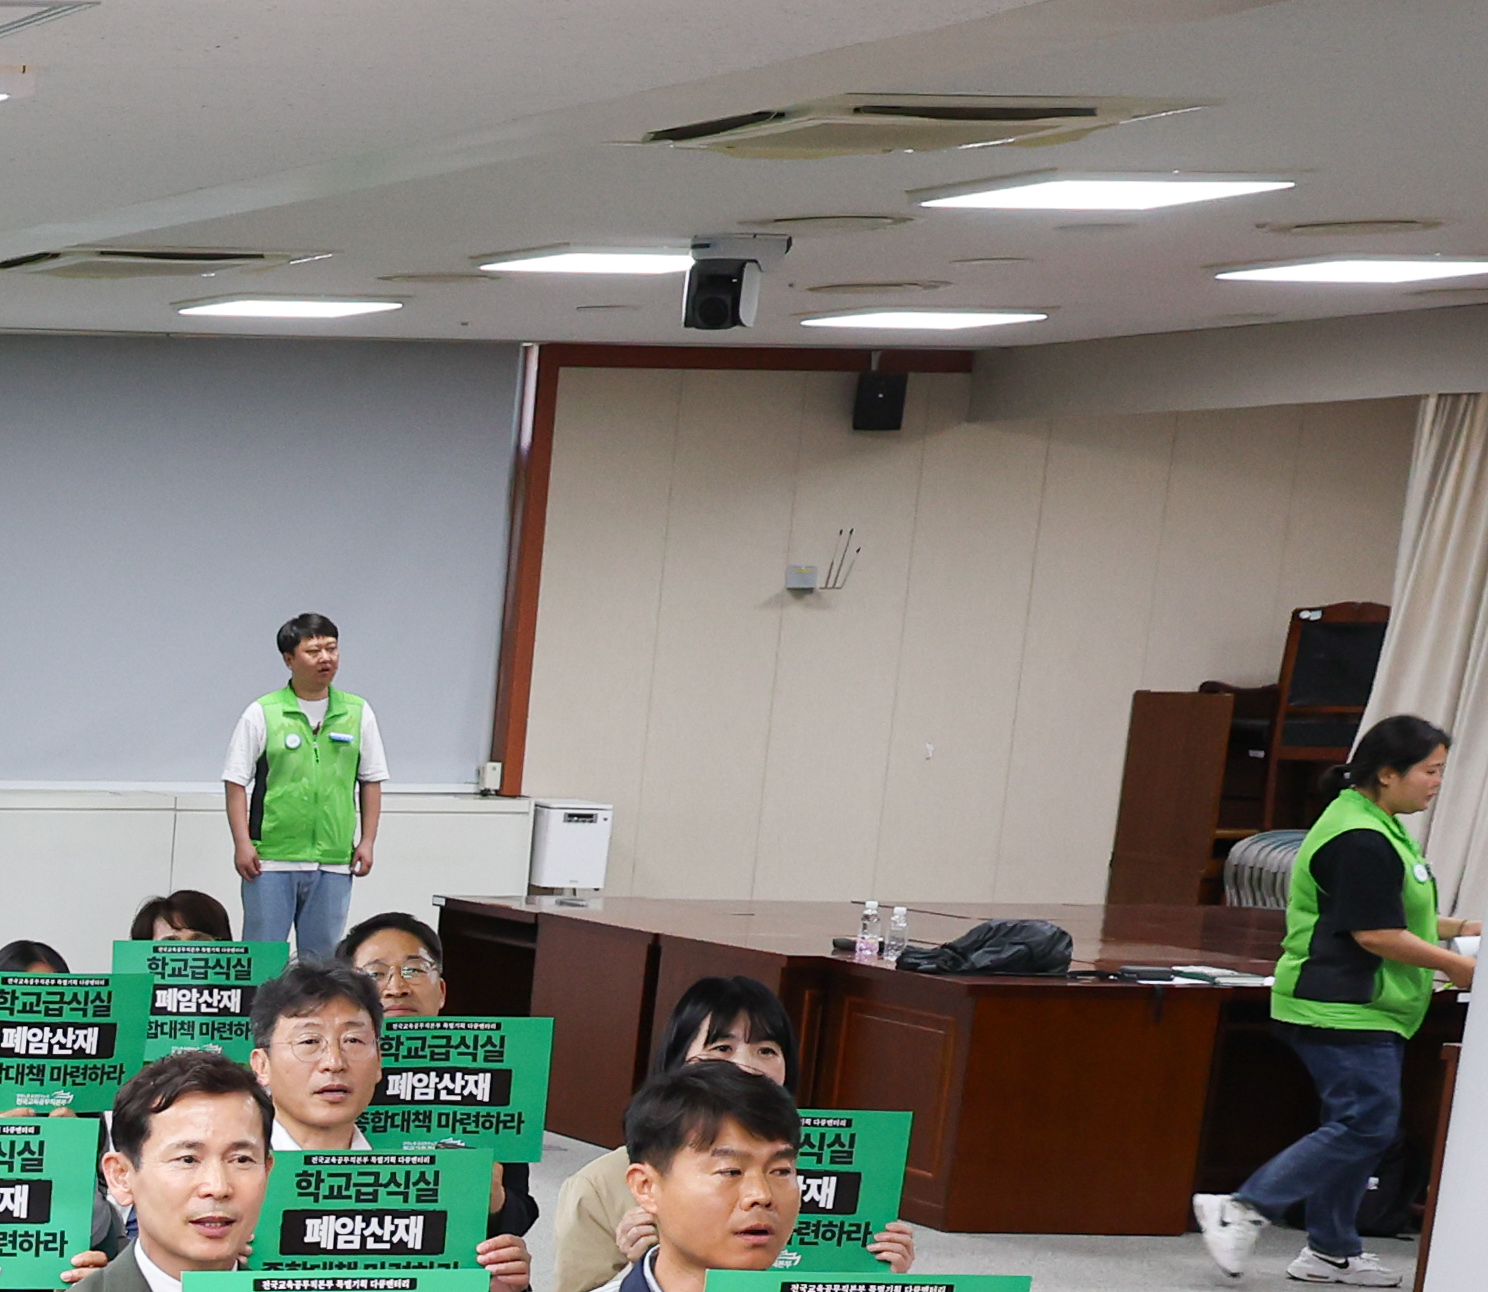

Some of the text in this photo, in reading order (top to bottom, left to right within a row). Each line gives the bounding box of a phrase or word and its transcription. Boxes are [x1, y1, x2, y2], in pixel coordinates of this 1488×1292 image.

[146, 955, 252, 980] 학교급식실
[155, 987, 241, 1013] 폐암산재
[1, 1026, 98, 1054] 폐암산재
[146, 1019, 250, 1040] 합대책 마련하
[377, 1034, 505, 1062] 학교급식실
[48, 1063, 126, 1086] 마련하라
[385, 1071, 491, 1101] 폐암산재
[436, 1110, 525, 1135] 마련하라
[294, 1169, 440, 1203] 학교급식실
[303, 1214, 423, 1249] 폐암산재
[790, 1219, 872, 1247] 련하라
[335, 1279, 368, 1289] 특별기획
